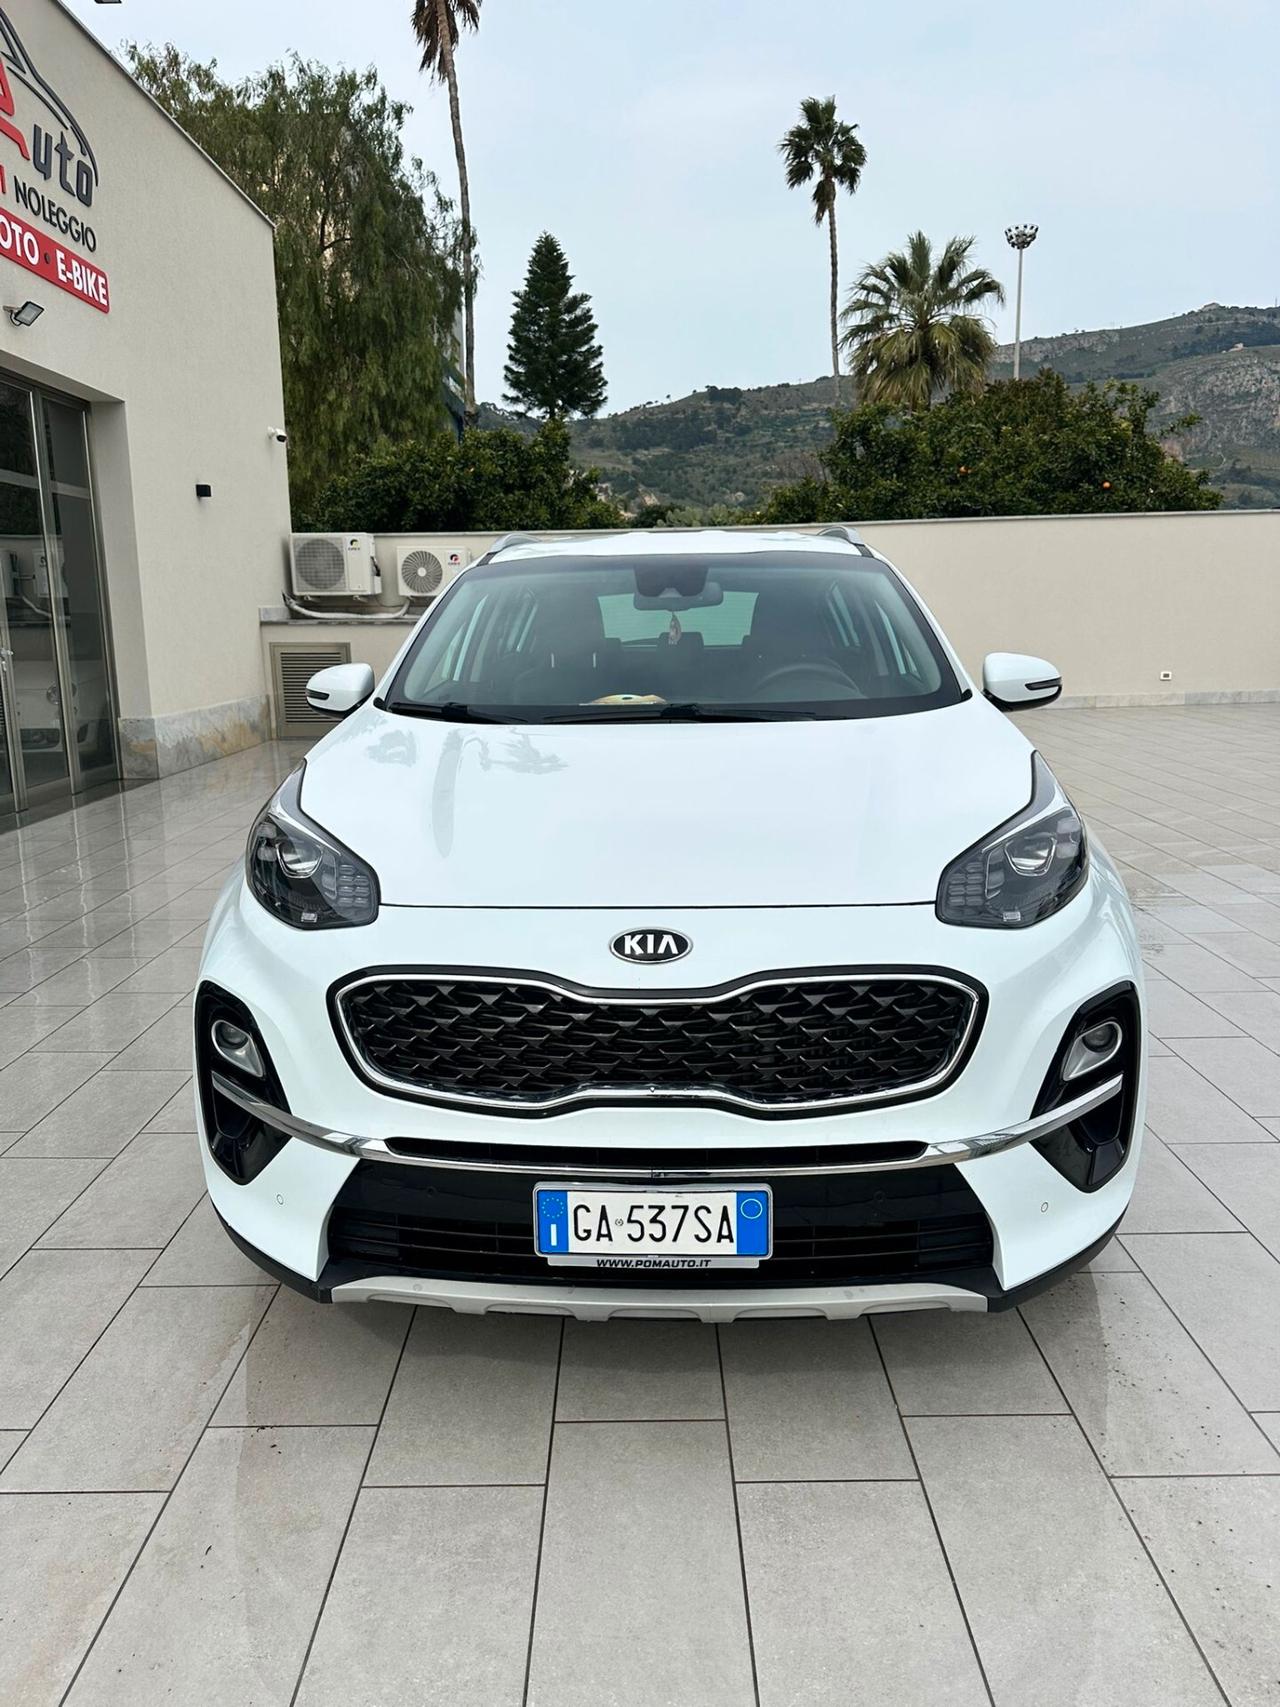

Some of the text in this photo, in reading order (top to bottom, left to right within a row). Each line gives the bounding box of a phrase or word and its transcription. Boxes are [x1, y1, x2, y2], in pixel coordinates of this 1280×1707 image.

[14, 175, 96, 253] NOLEGGIO
[55, 248, 108, 306] E-BIKE
[623, 933, 679, 955] KIA
[596, 1258, 712, 1268] WWW.POMAUTO.IT
